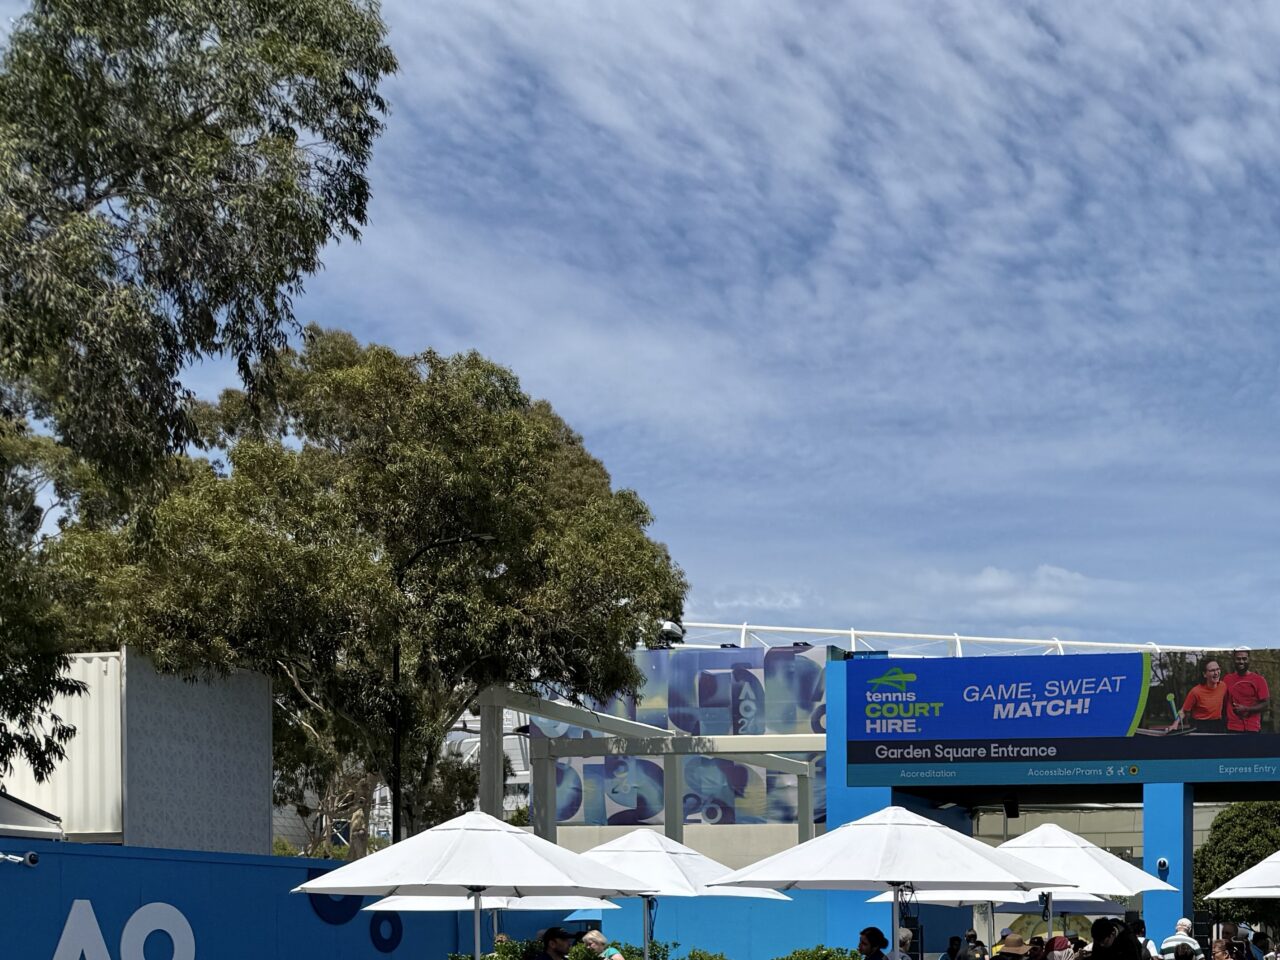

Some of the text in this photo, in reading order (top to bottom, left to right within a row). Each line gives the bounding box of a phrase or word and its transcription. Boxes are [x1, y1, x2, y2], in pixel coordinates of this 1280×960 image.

[865, 690, 916, 702] tennis
[963, 676, 1127, 702] GAME, SWEAT
[865, 702, 944, 718] COURT
[993, 697, 1091, 720] MATCH!
[875, 743, 1057, 762] Garden Square Entrance
[900, 769, 956, 778] Accreditation
[1028, 766, 1103, 777] Accessible/Prams
[1219, 764, 1277, 776] Express Entry
